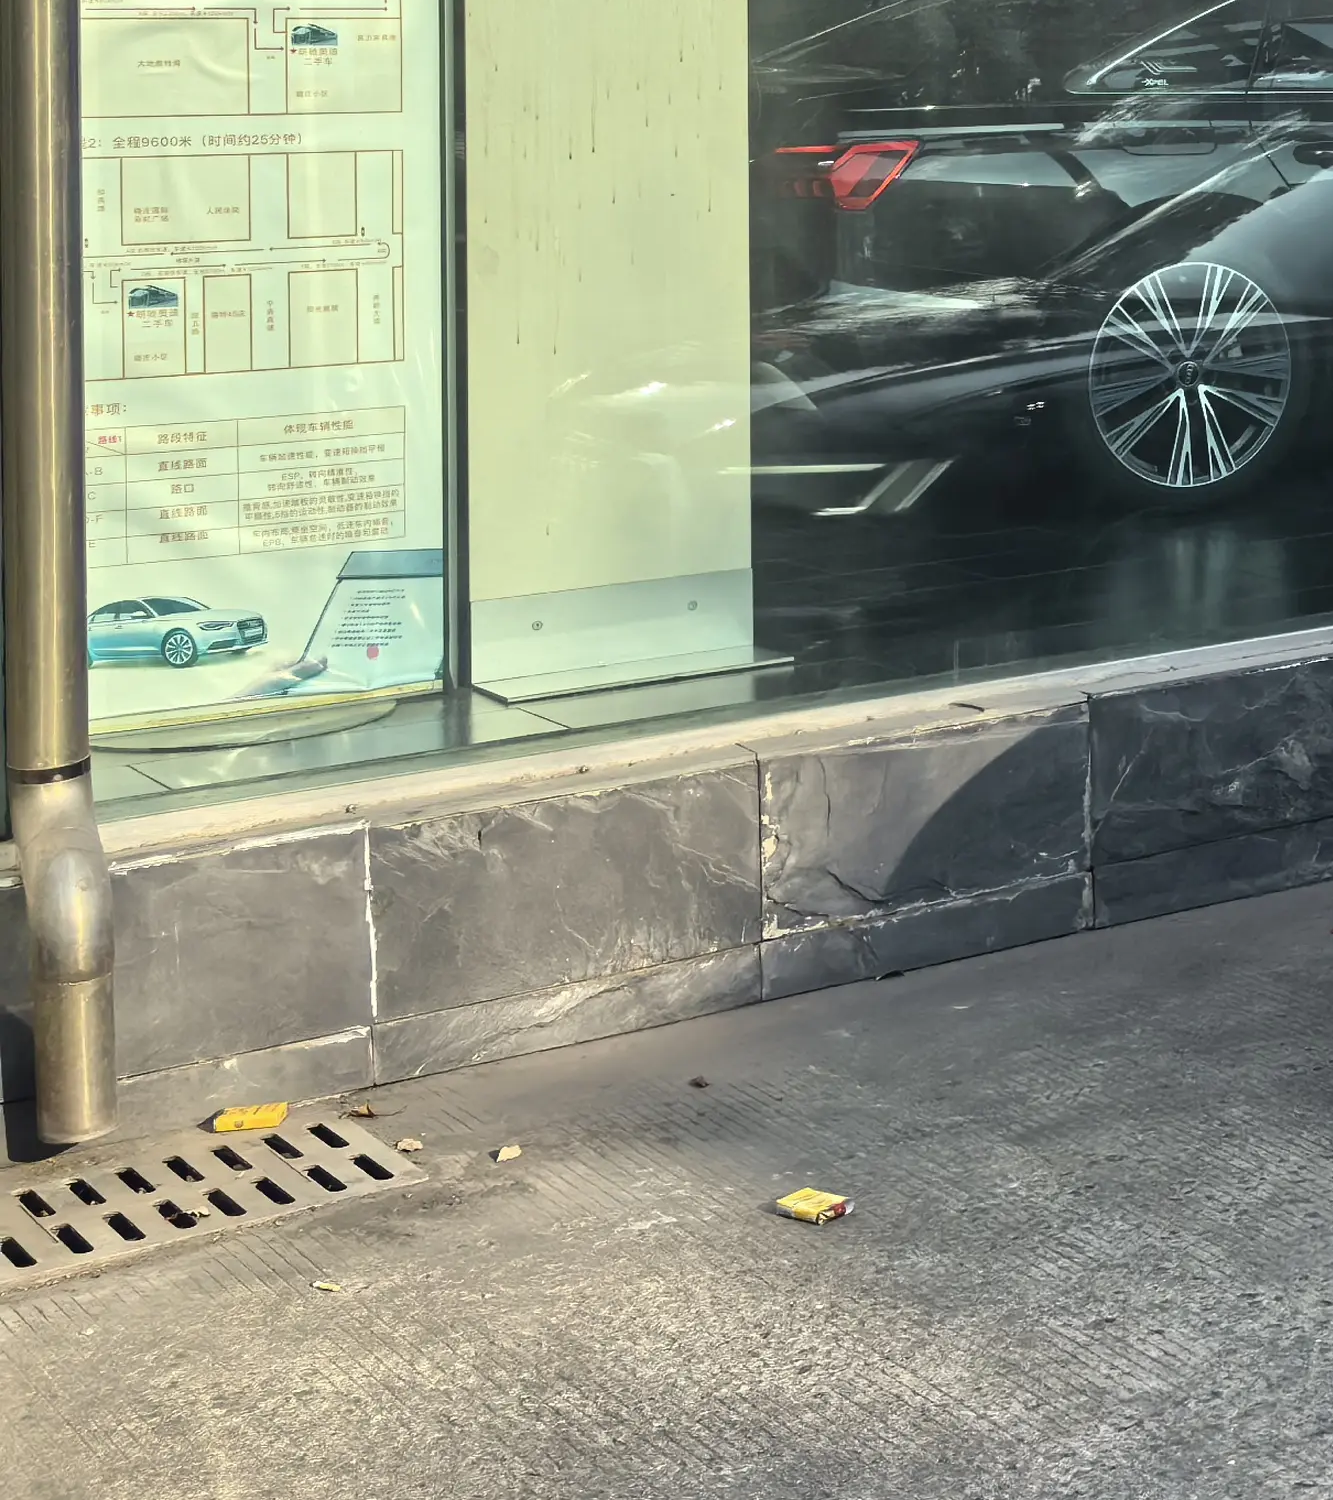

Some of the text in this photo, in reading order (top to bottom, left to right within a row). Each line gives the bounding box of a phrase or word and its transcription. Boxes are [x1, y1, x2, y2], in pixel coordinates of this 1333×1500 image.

[157, 431, 208, 445] 路段特征
[157, 457, 208, 472] 直线路面
